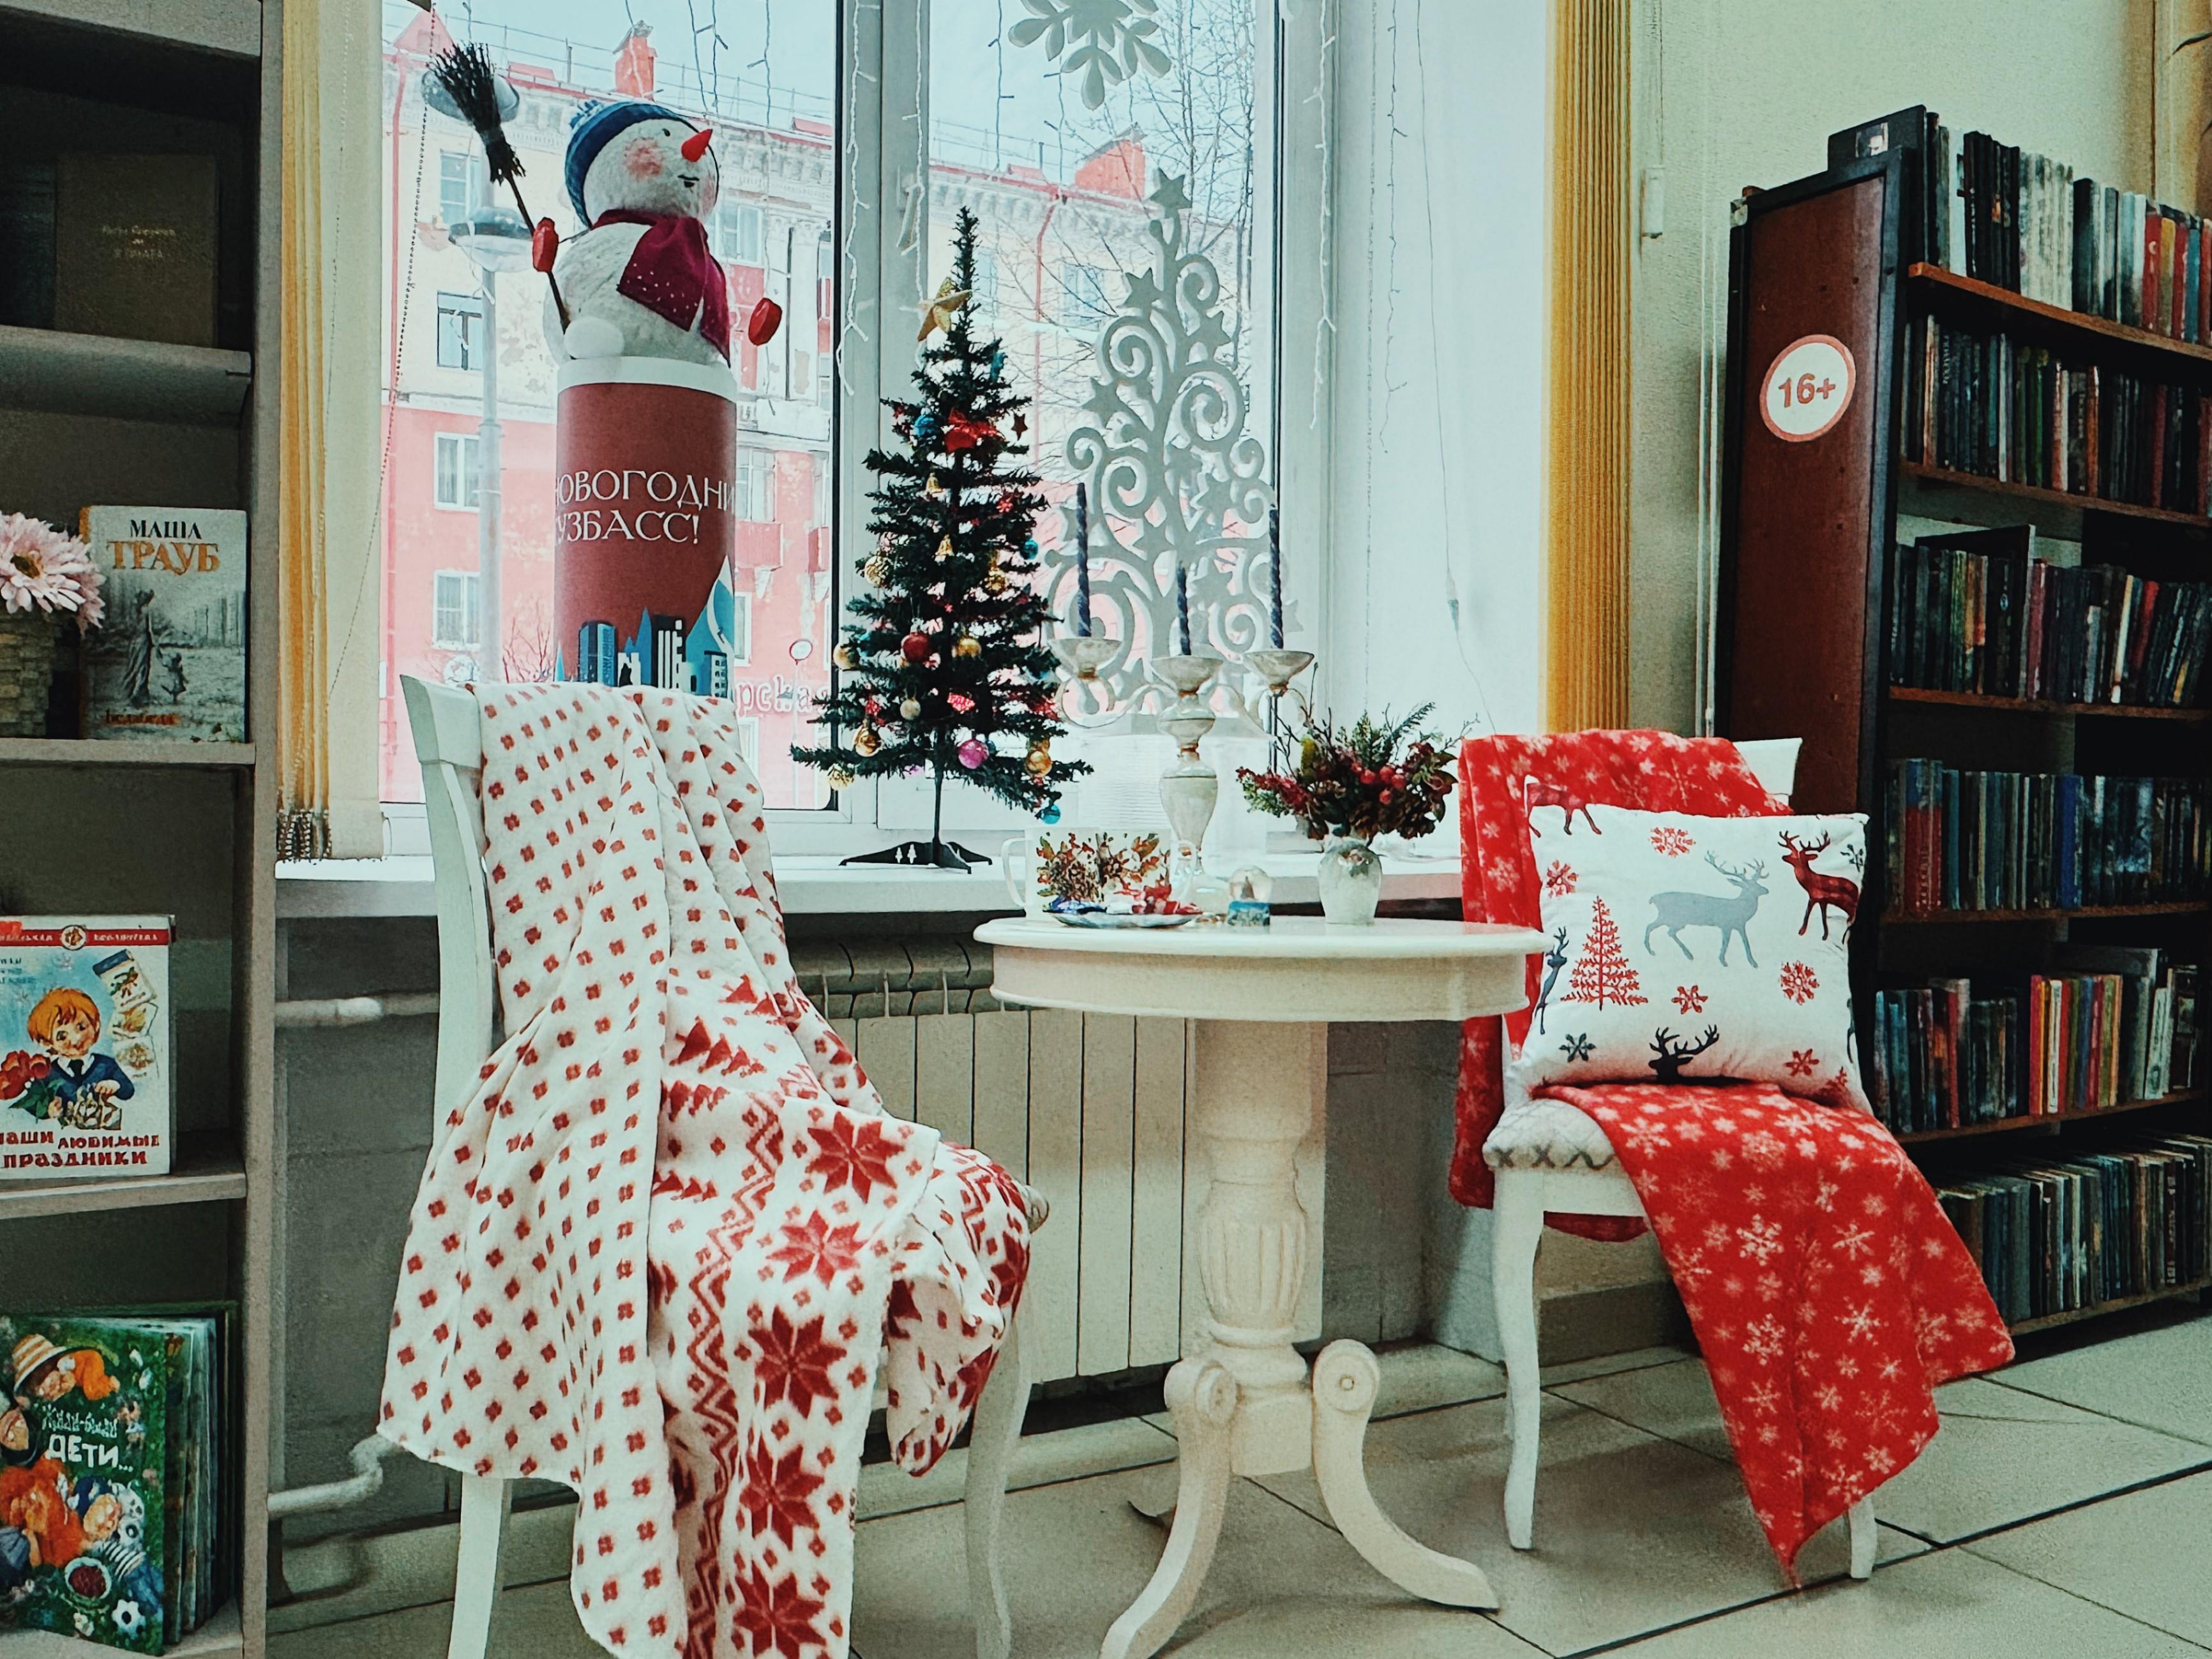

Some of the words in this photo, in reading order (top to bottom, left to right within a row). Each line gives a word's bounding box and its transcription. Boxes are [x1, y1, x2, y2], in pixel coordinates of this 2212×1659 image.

[1778, 373, 1837, 408] 16+
[130, 519, 202, 540] МАША
[106, 540, 221, 576] ТРАУБ
